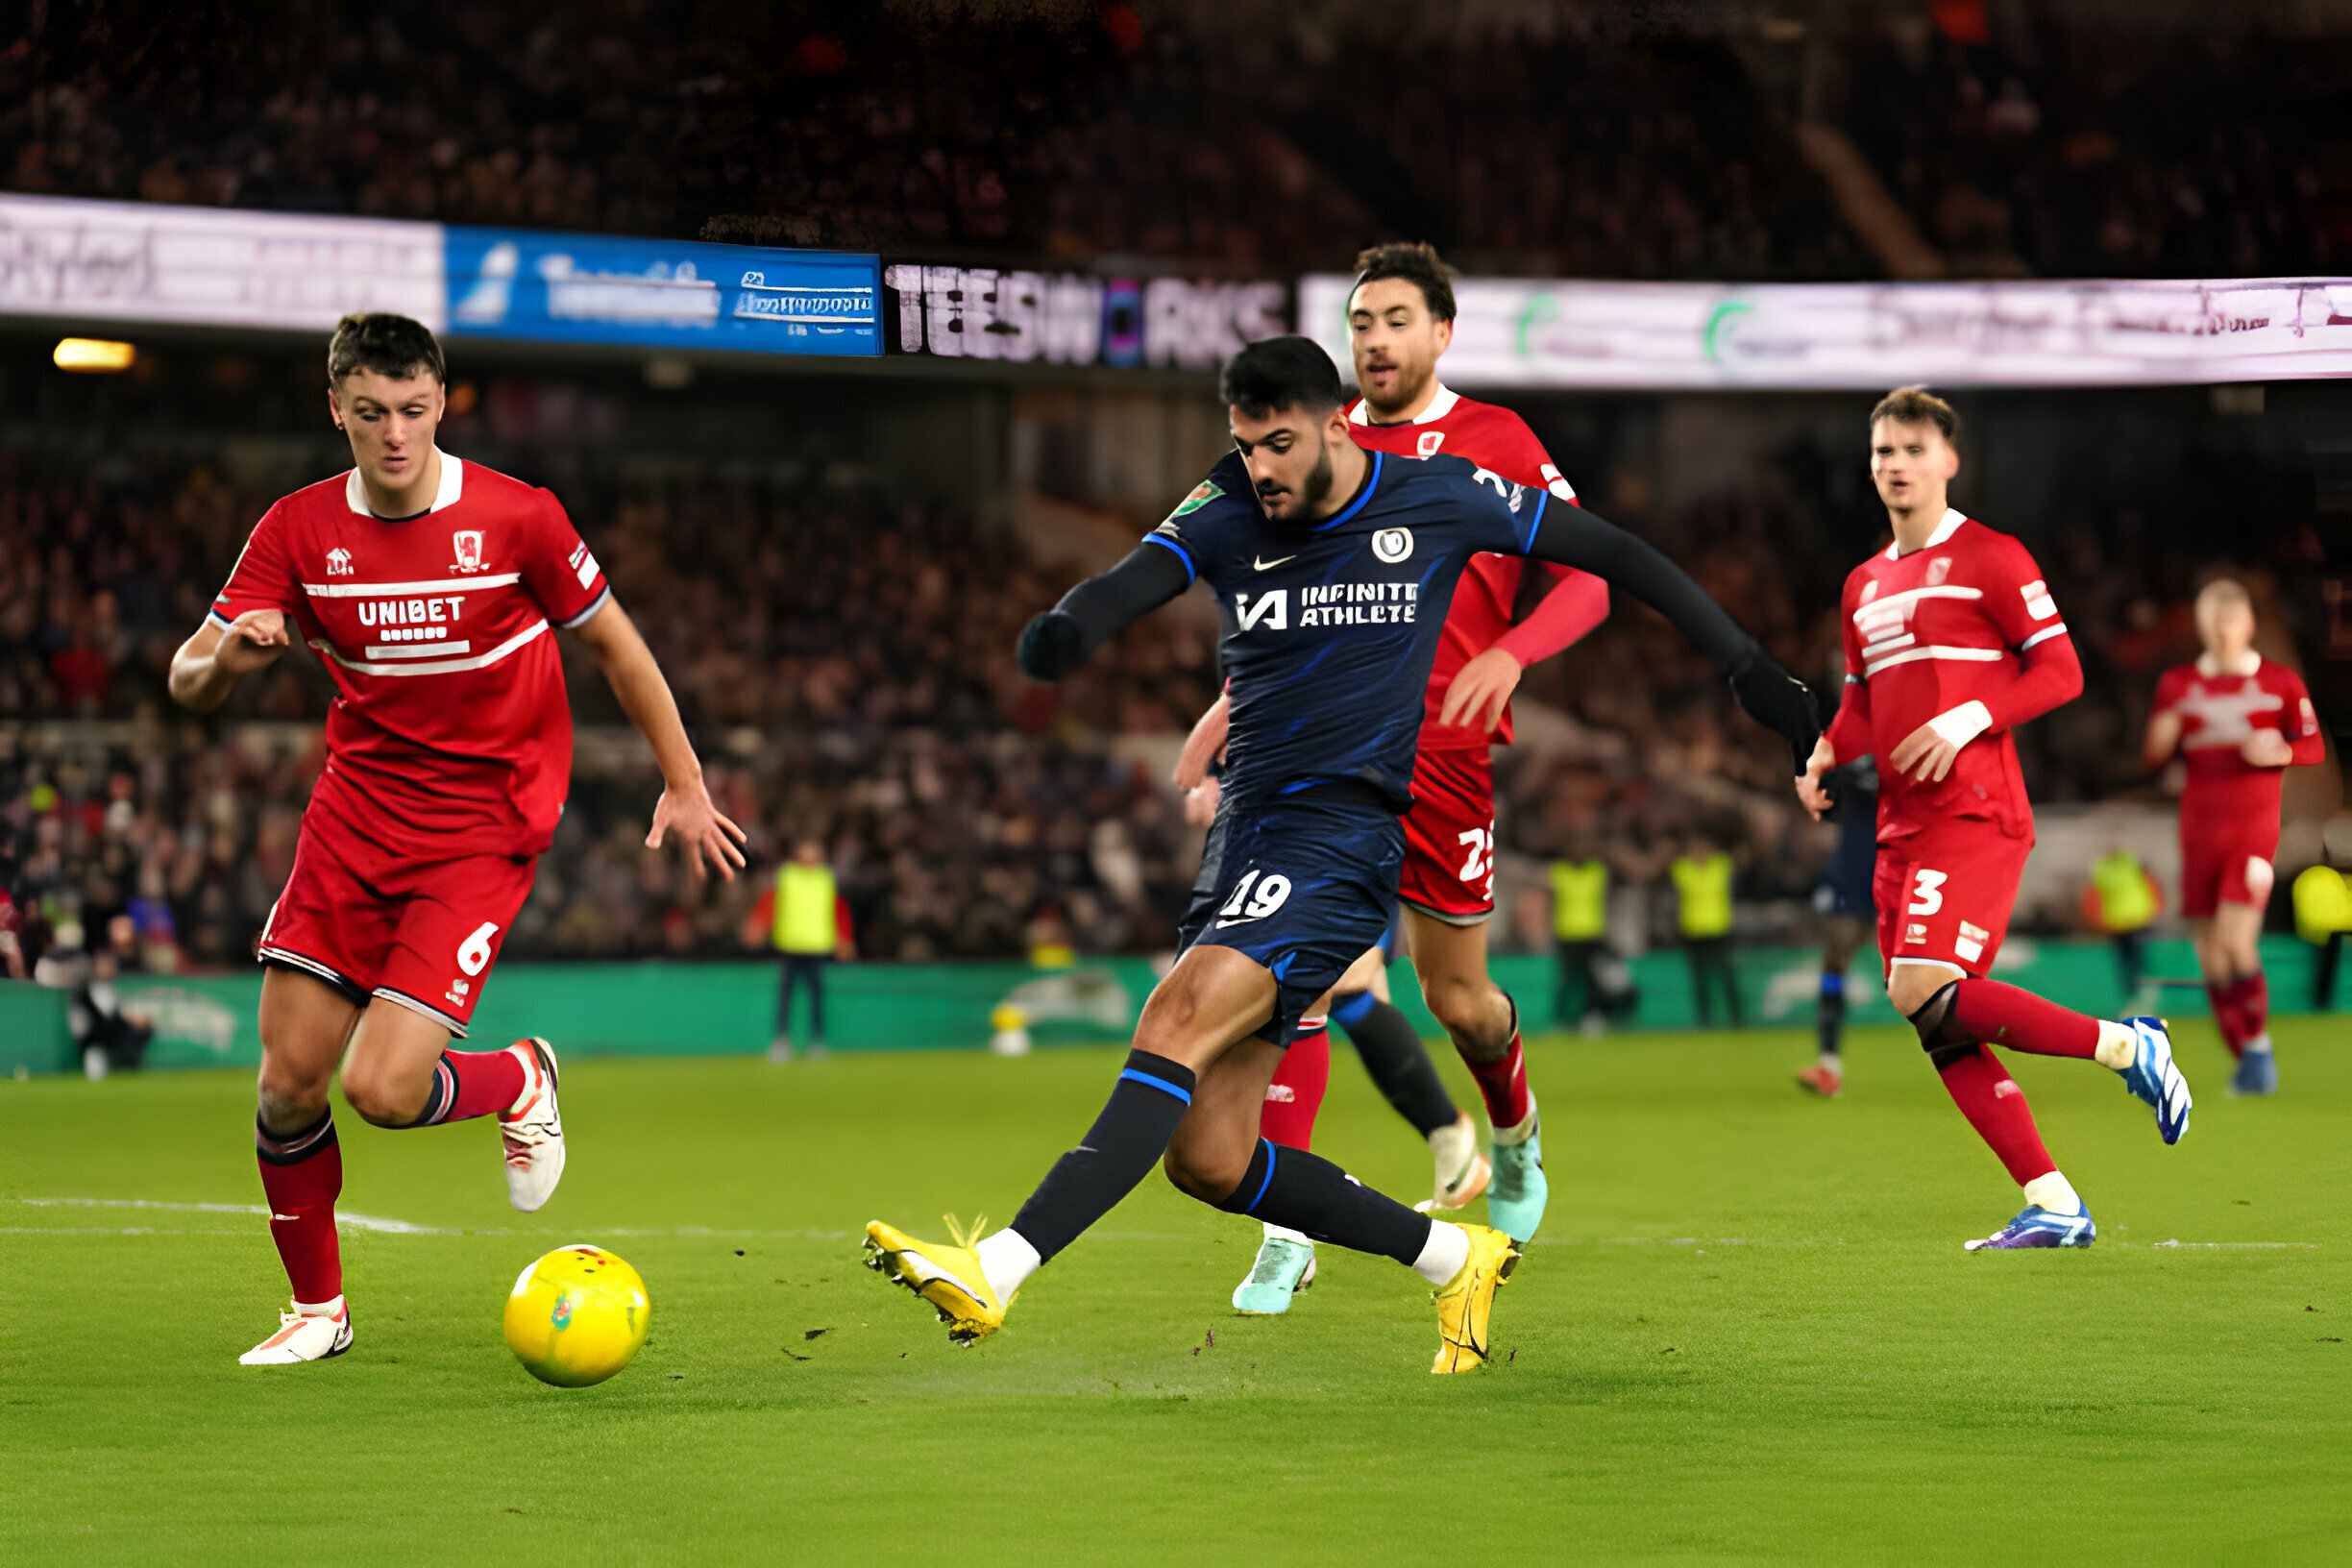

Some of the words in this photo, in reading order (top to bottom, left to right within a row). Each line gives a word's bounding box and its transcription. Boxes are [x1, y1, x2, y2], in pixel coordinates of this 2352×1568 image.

[358, 596, 466, 626] UNIBET
[1299, 604, 1418, 626] ATHLETE
[1218, 869, 1292, 919] 19
[1908, 869, 1948, 916] 3
[456, 921, 500, 977] 6
